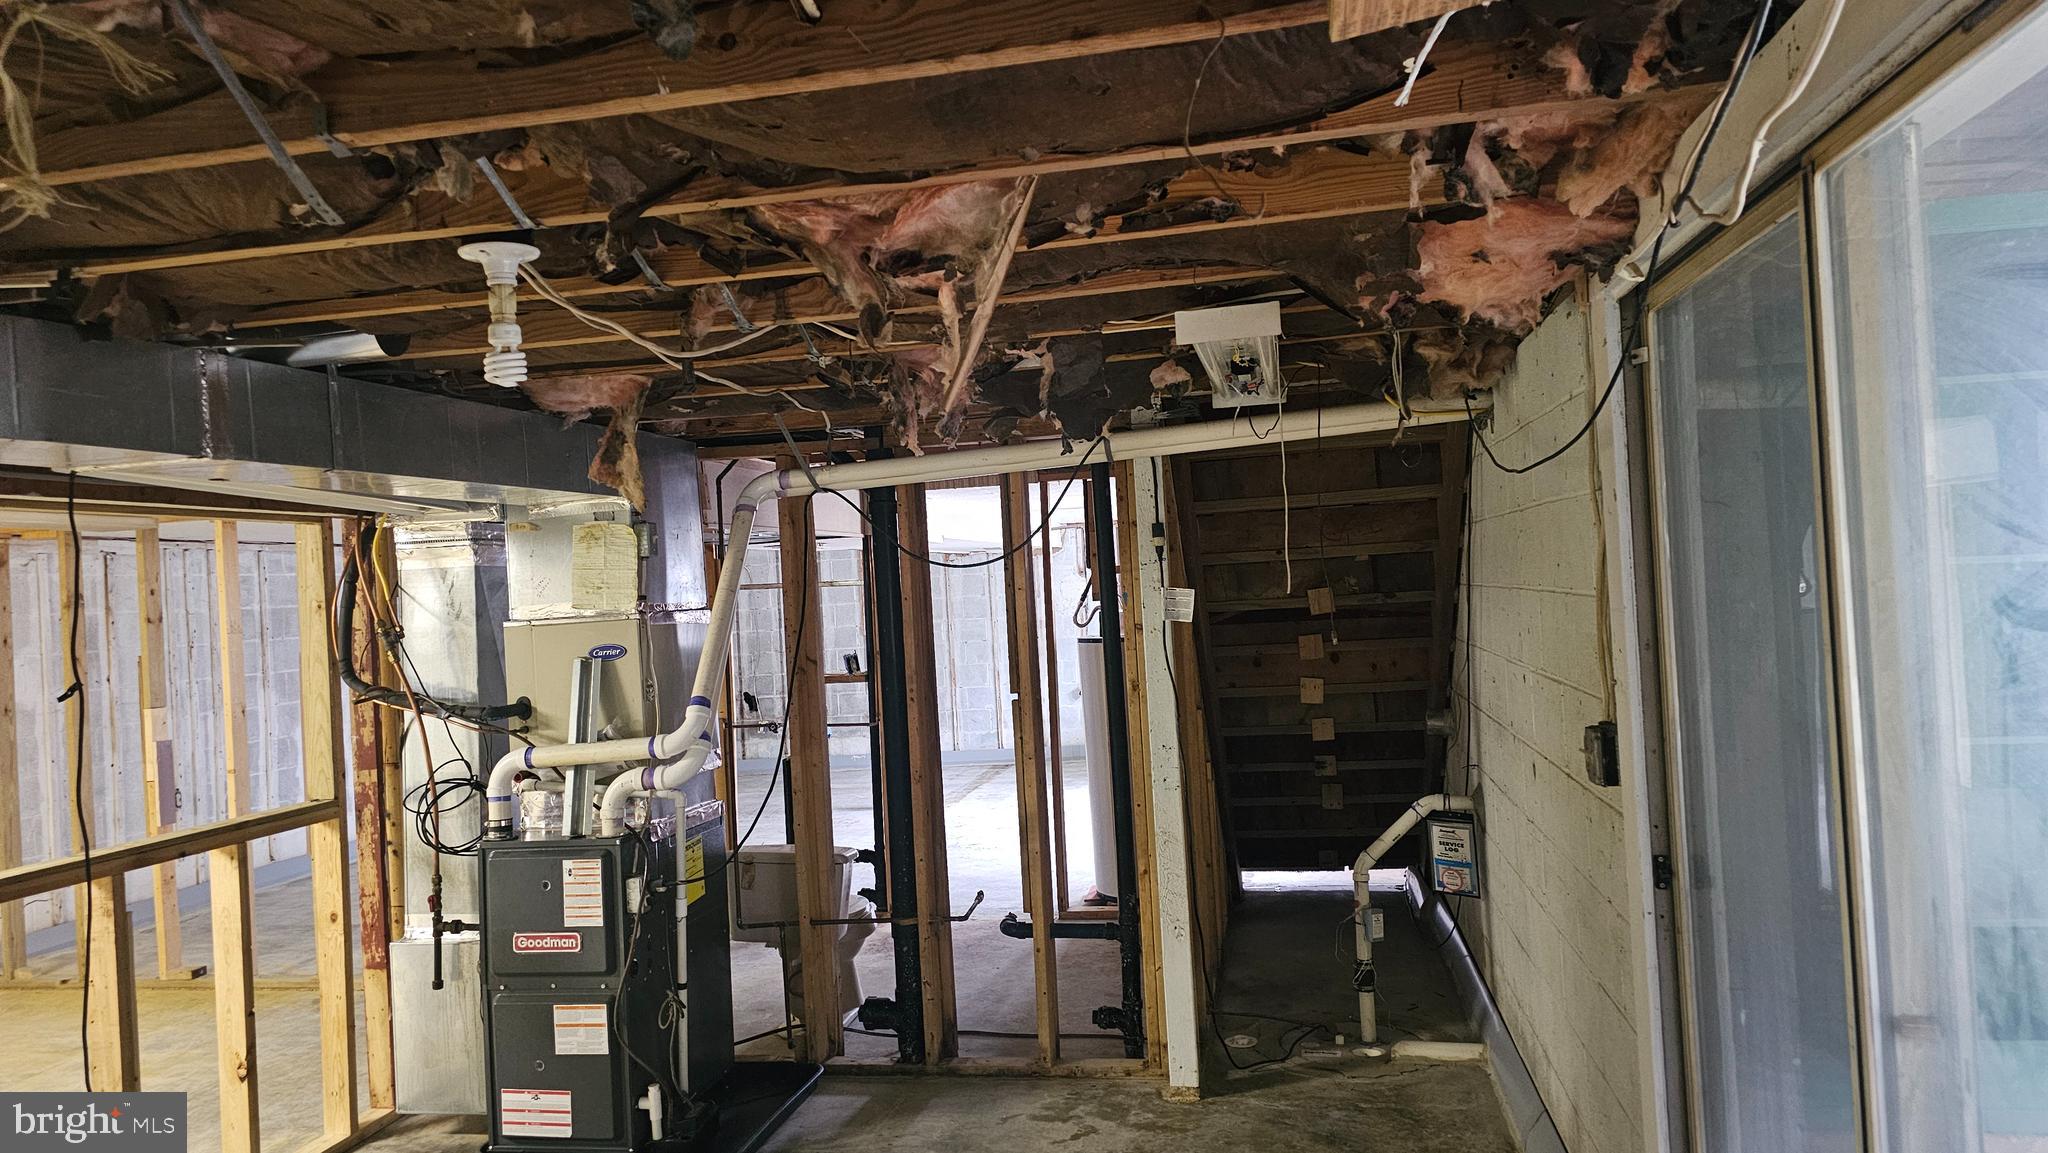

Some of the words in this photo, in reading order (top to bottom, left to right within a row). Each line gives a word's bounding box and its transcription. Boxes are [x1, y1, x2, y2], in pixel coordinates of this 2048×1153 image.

[592, 648, 621, 657] Carrier
[1438, 840, 1465, 849] SERVICE
[517, 936, 577, 949] Goodman
